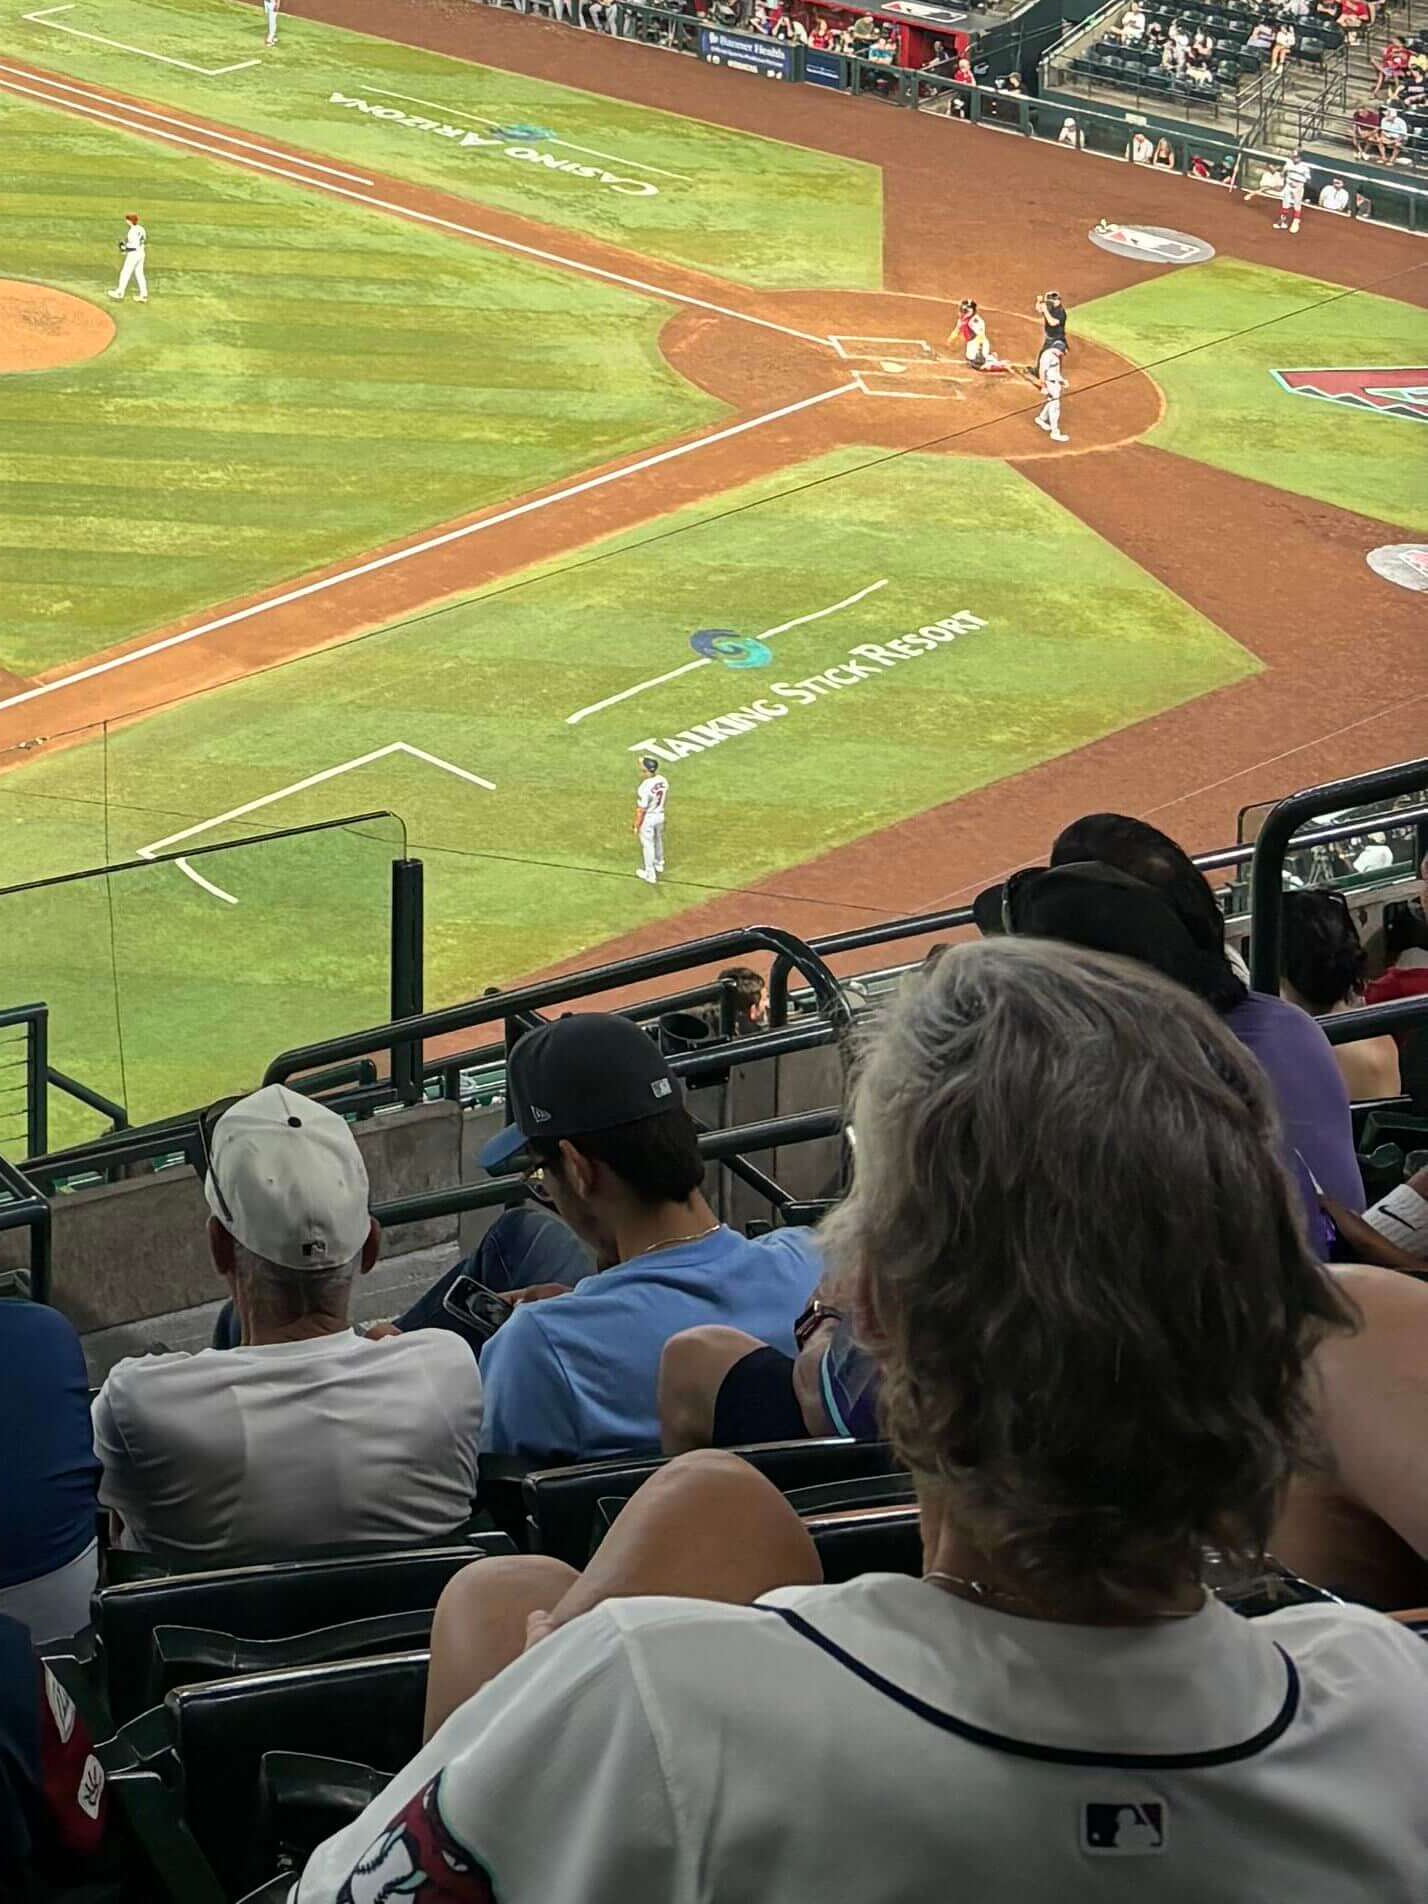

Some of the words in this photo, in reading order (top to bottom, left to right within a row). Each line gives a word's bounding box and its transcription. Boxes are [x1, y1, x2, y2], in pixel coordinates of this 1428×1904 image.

[328, 91, 505, 147] ARIZONA
[504, 146, 660, 197] CASINO
[628, 698, 789, 763] TALKING
[769, 659, 883, 706] STICK
[847, 609, 990, 668] RESORT
